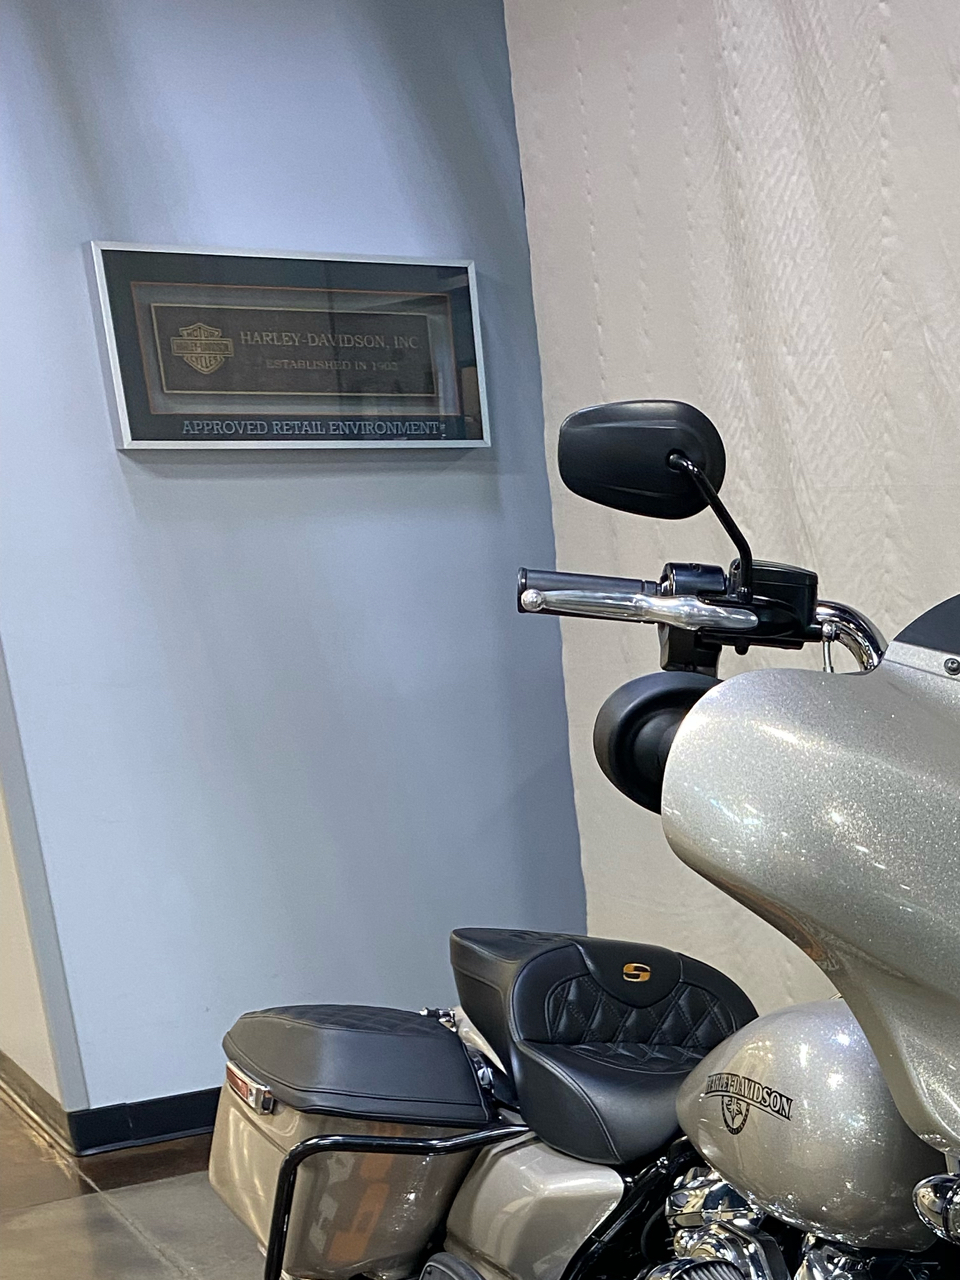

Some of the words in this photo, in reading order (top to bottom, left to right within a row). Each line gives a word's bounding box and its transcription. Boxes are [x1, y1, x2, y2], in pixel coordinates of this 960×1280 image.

[240, 331, 390, 349] HARLEY-DAVIDSON,
[266, 359, 351, 371] ESTABLISHED
[354, 361, 367, 371] IN
[182, 420, 268, 435] APPROVED
[272, 421, 325, 435] RETAIL
[328, 421, 439, 435] ENVIRONMENT
[706, 1074, 793, 1120] HARLEY-DAVIDSON
